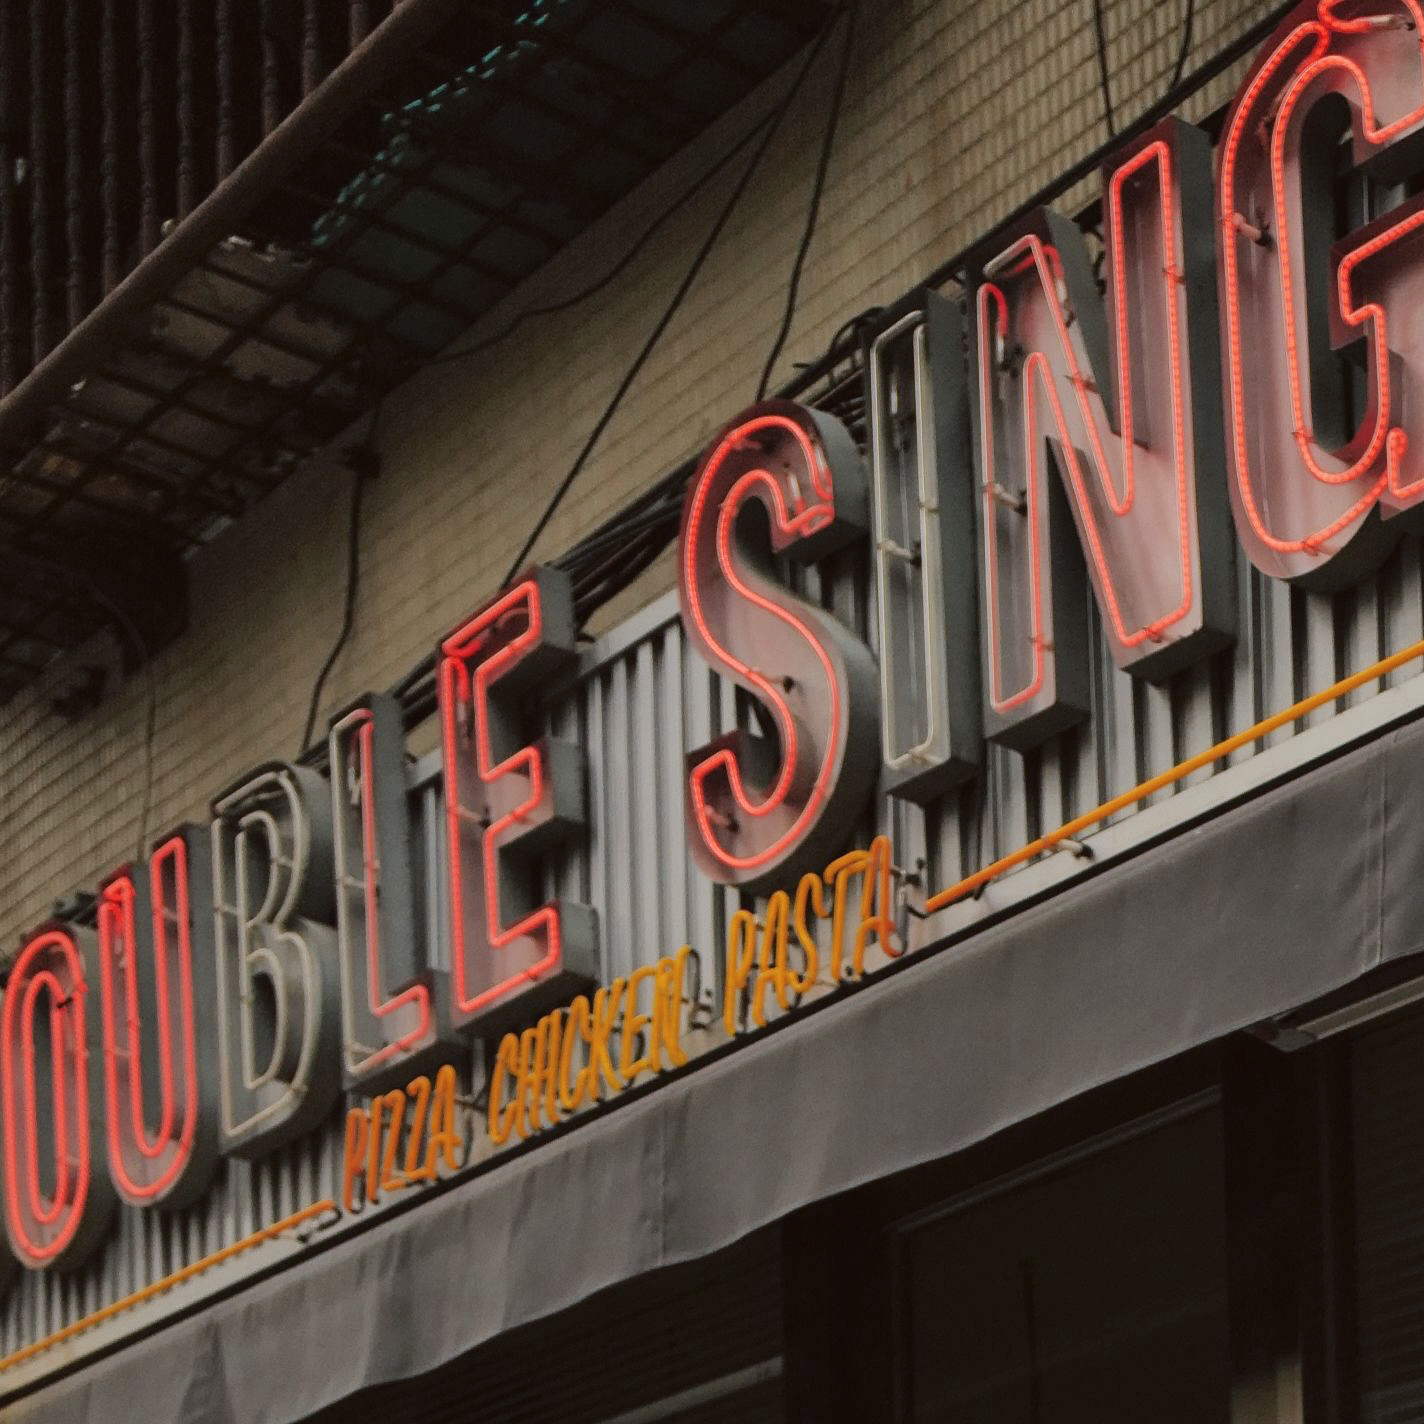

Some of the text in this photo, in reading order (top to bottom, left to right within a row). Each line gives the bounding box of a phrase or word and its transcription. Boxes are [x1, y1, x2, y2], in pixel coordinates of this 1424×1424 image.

[3, 567, 592, 1270] OUBLE
[344, 835, 904, 1213] PIZZA CHICKEN PASTA
